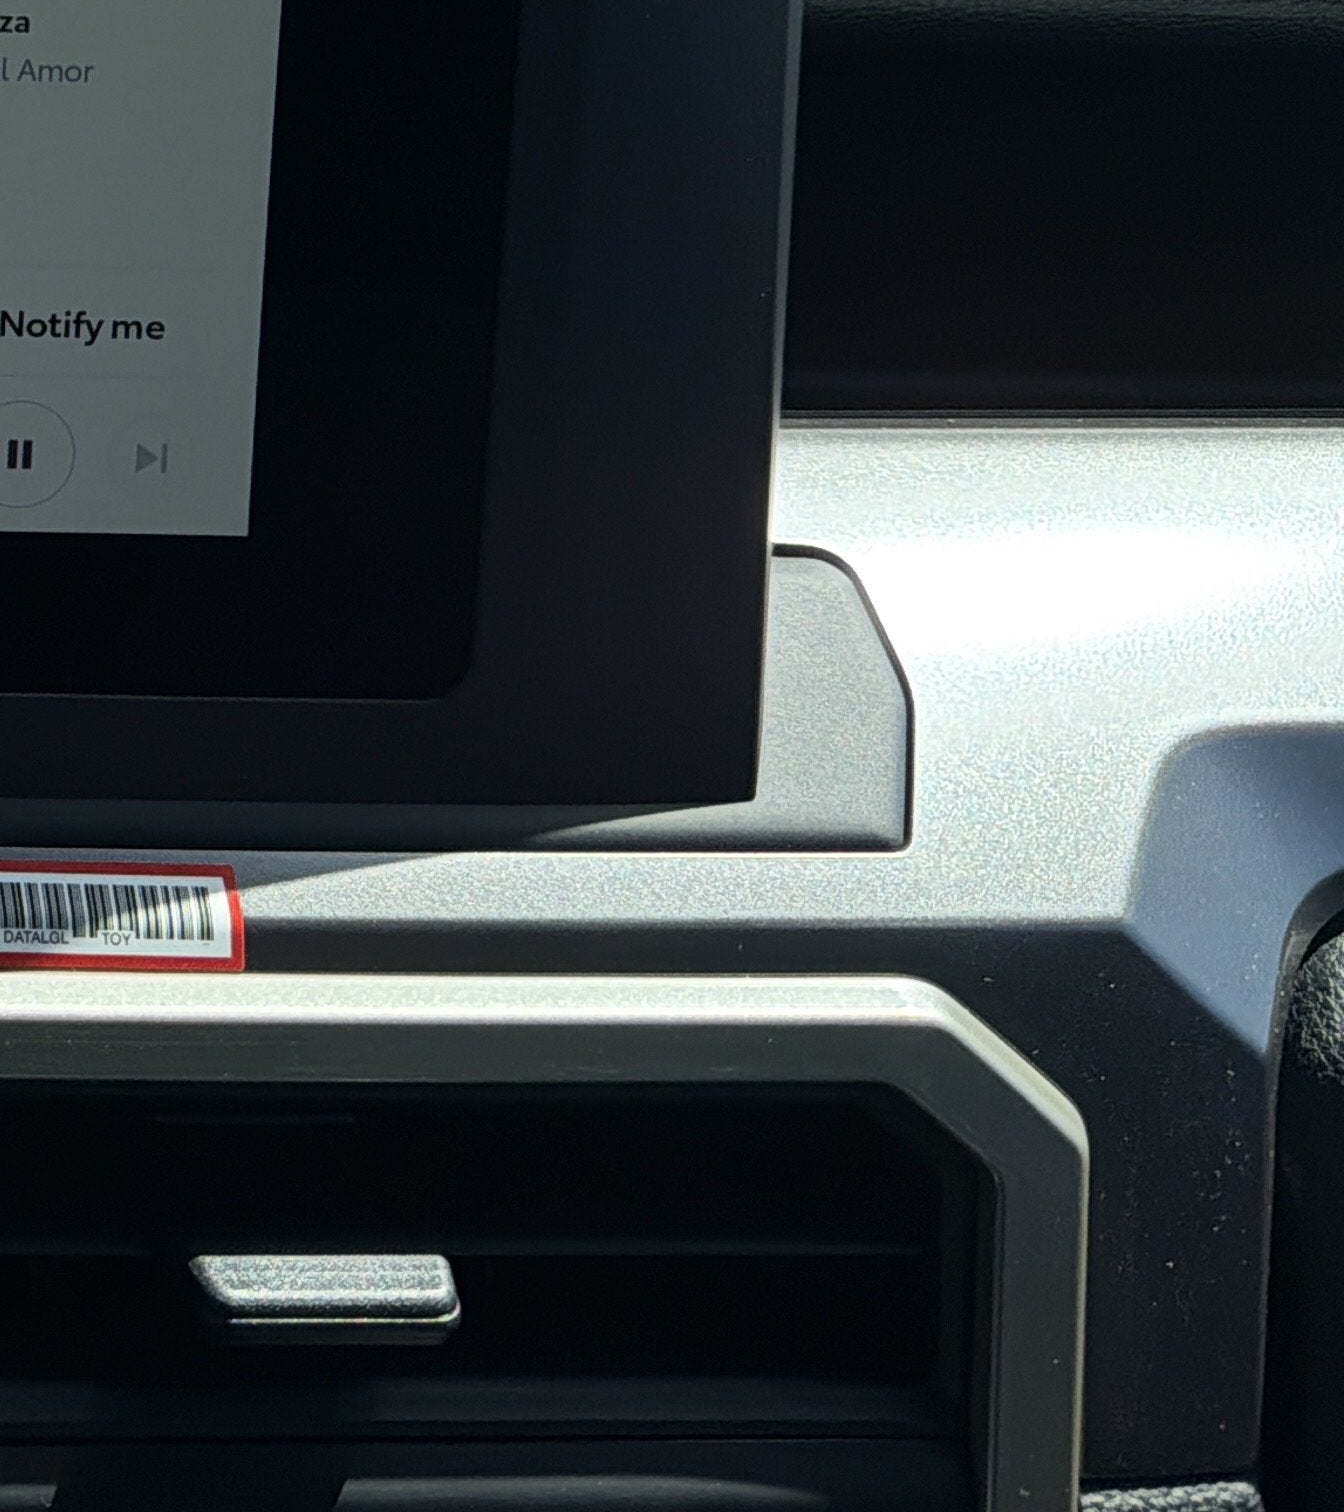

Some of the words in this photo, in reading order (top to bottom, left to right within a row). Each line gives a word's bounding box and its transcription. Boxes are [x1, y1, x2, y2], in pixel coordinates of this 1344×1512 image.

[16, 58, 95, 83] Amor
[110, 317, 166, 341] me
[100, 931, 133, 946] TOY
